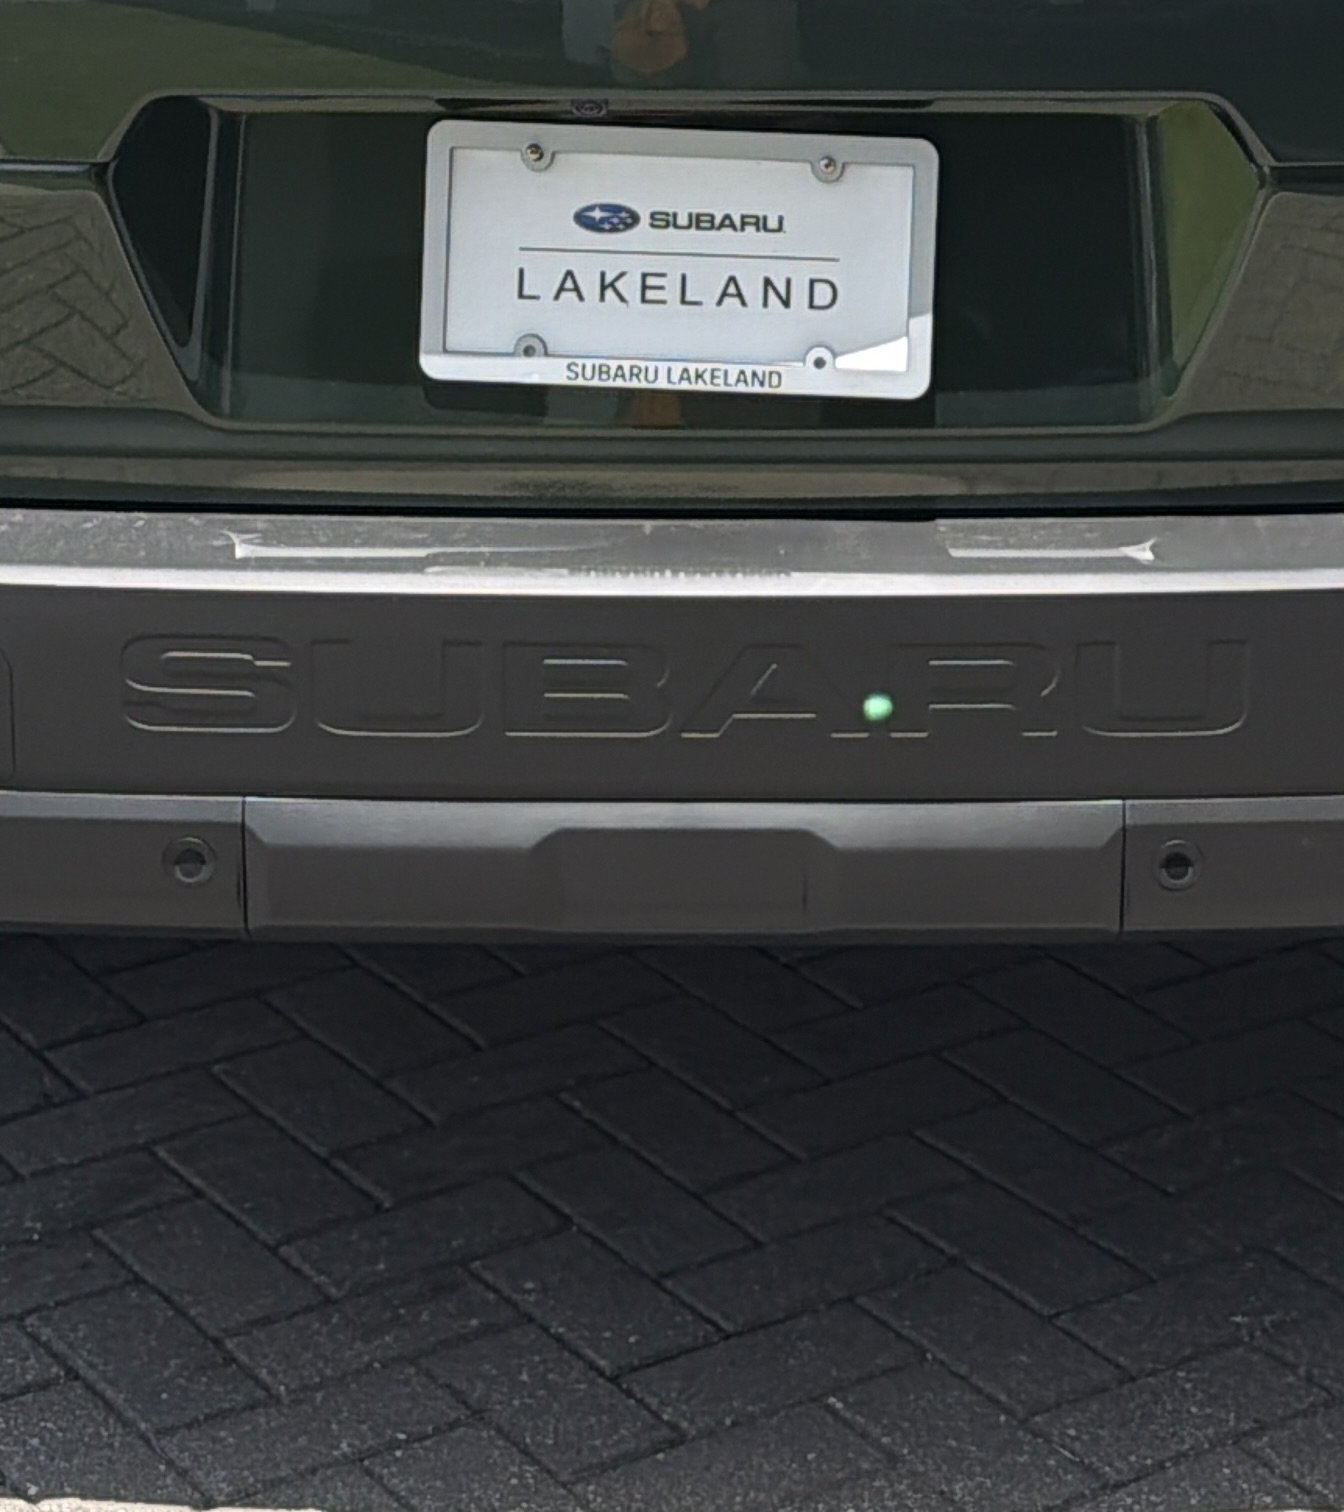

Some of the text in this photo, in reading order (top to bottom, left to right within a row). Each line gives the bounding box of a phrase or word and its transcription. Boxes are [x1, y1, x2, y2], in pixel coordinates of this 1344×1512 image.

[648, 210, 787, 235] SUBARU
[516, 266, 840, 311] LAKELAND
[565, 361, 783, 389] SUBARU LAKELAND
[120, 632, 1248, 740] SUBARU
